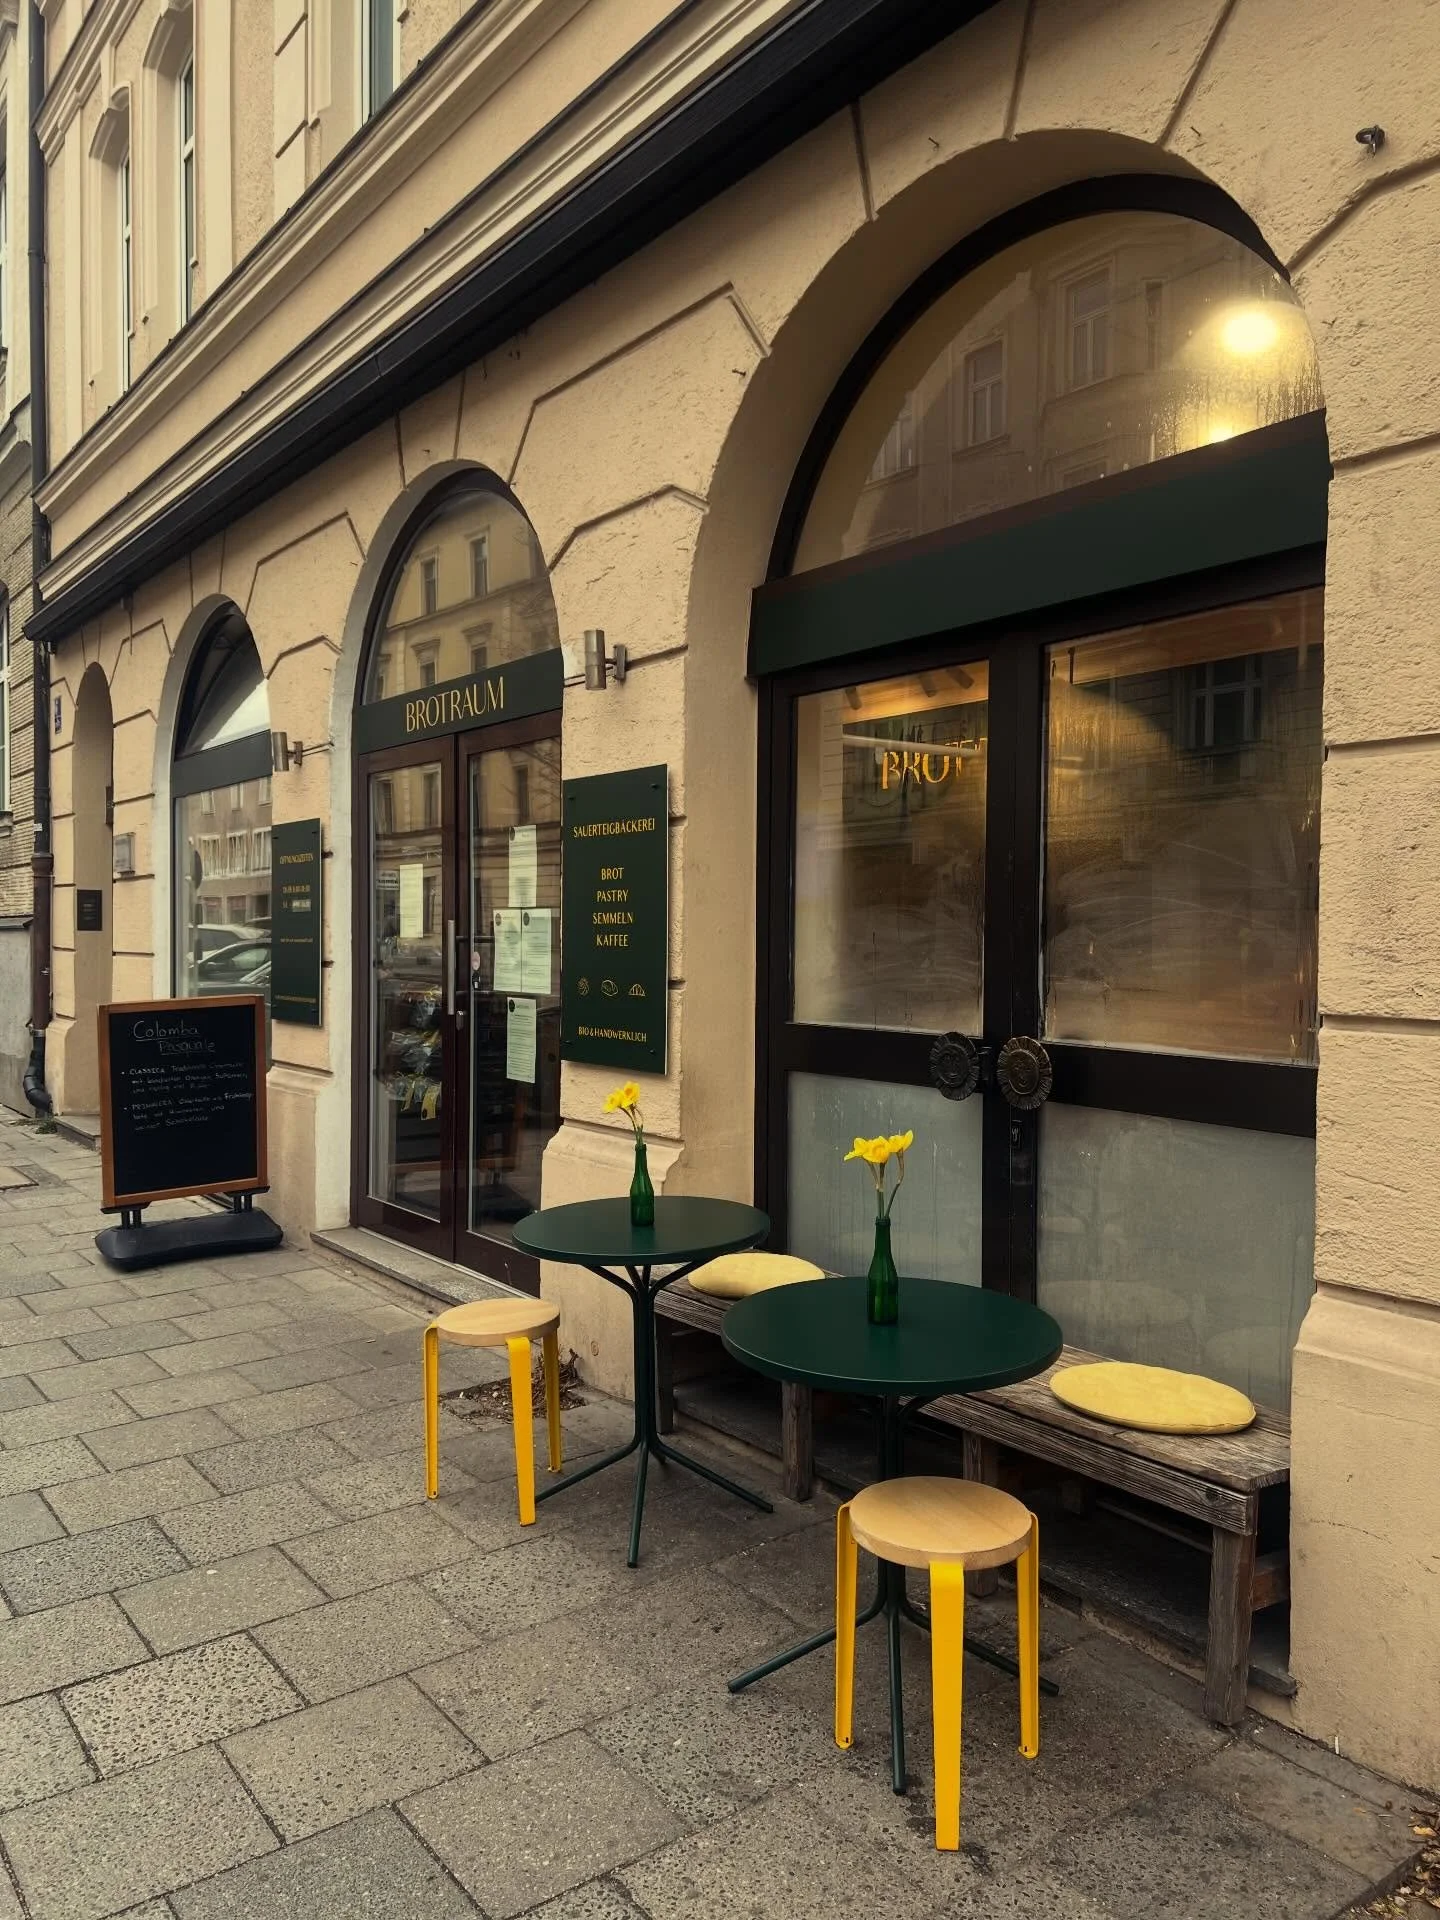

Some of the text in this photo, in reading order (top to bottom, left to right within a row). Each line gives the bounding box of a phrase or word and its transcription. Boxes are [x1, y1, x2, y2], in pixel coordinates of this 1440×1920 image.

[405, 675, 505, 733] BROTRAUM
[600, 867, 625, 881] BROT
[596, 889, 629, 903] PASTRY
[592, 911, 634, 925] SEMMELN
[596, 934, 629, 947] KAFFEE
[132, 1019, 199, 1039] Colomba
